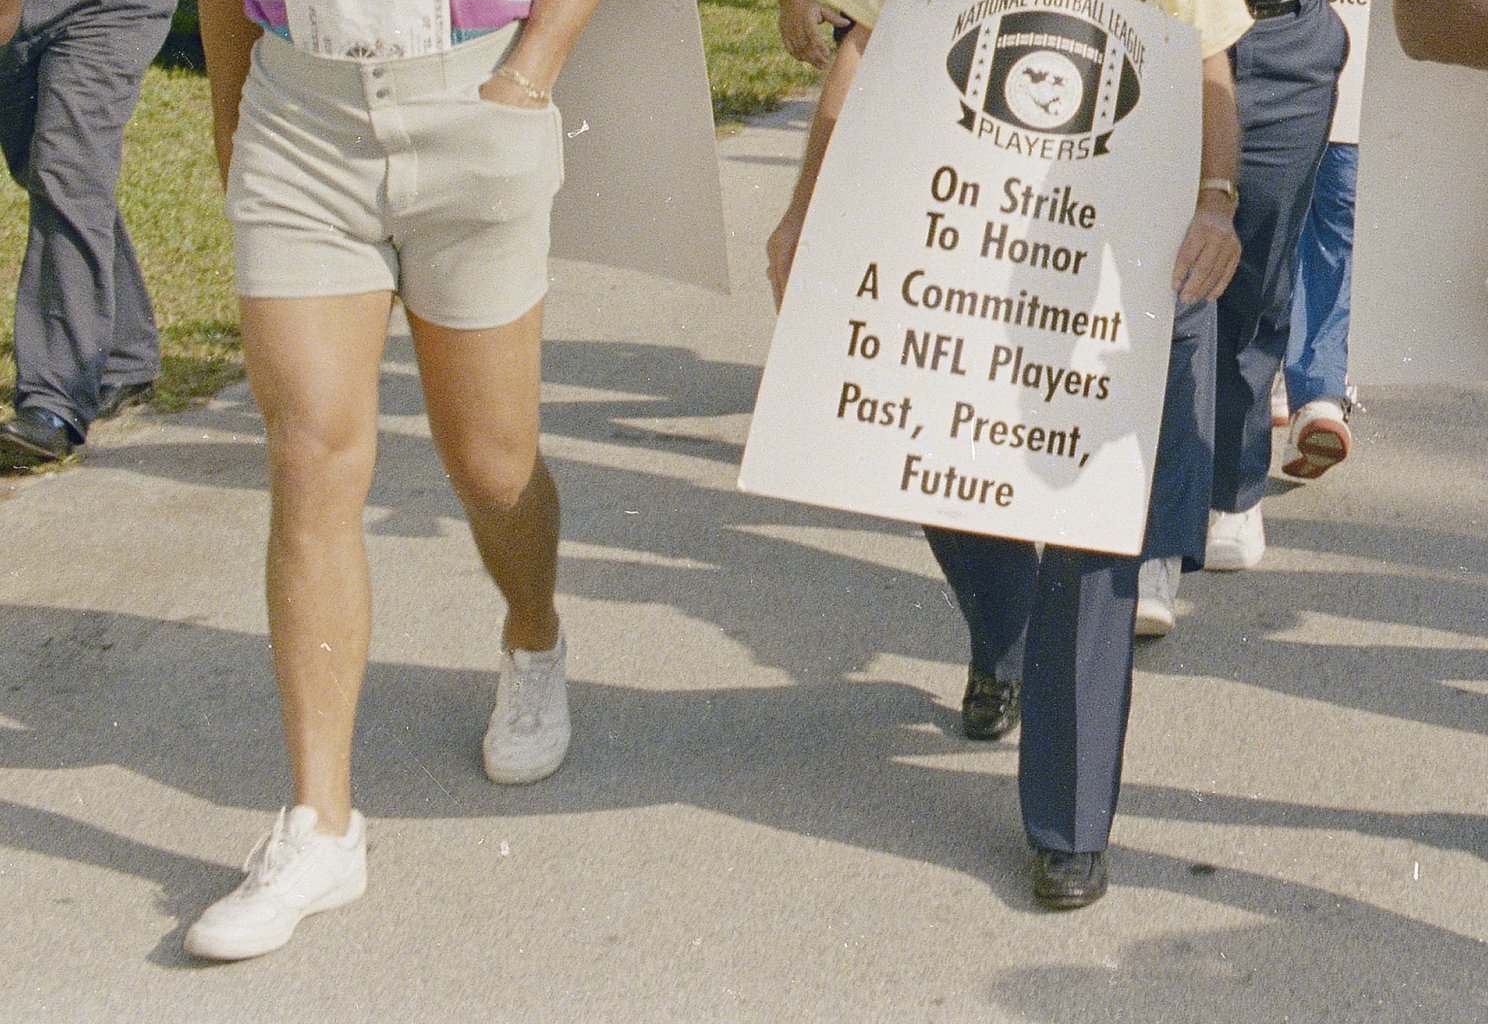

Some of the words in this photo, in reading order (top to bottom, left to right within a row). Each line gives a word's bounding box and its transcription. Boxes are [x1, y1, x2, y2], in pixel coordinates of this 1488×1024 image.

[1109, 9, 1145, 78] LEAGUE
[978, 117, 1091, 160] PLAYERS
[931, 166, 980, 206] On
[1000, 178, 1096, 229] Strike
[925, 211, 960, 251] To
[980, 222, 1088, 274] Honor
[856, 263, 879, 300] A
[901, 270, 1122, 342] Commitment
[847, 320, 881, 360] To
[900, 329, 966, 376] NFL
[988, 344, 1111, 403] Players
[837, 381, 925, 439] Past,
[950, 401, 1090, 467] Present,
[900, 453, 1014, 507] Future
